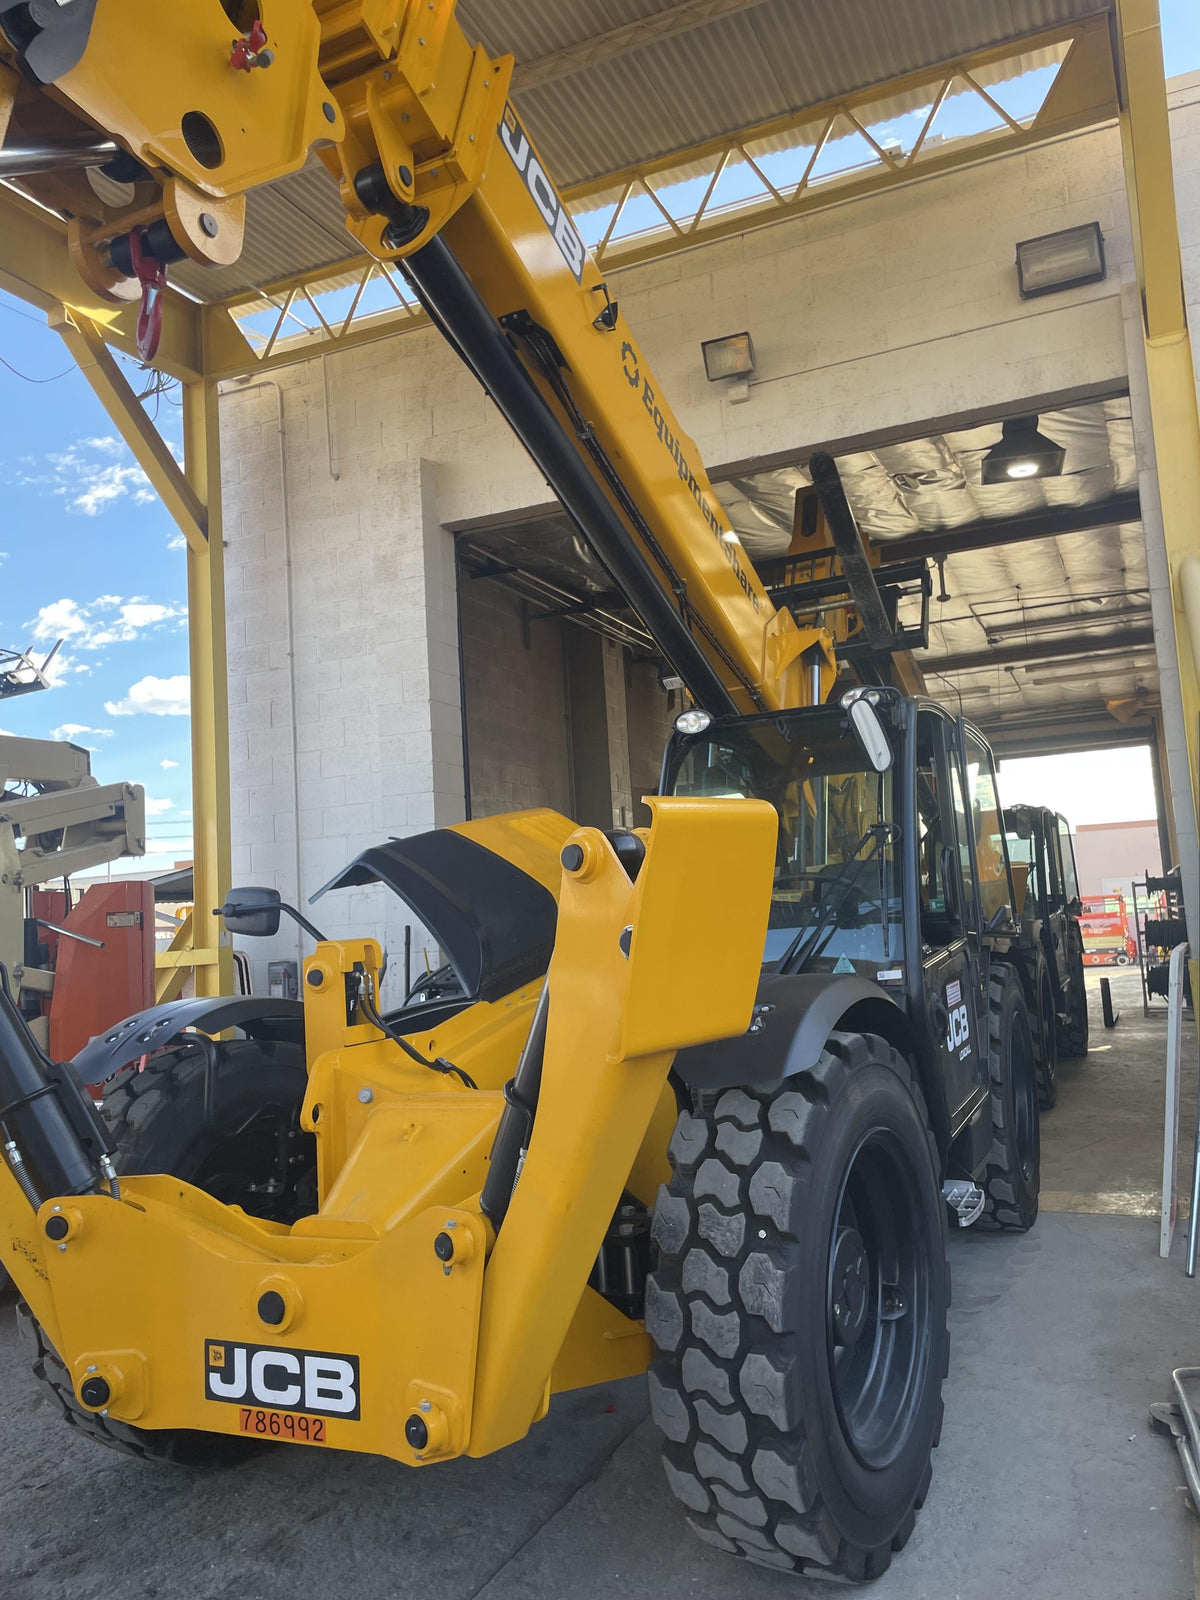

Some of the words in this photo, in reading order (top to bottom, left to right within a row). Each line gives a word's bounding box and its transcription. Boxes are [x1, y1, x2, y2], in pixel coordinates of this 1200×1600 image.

[501, 121, 584, 276] JCB
[946, 1004, 970, 1052] JCB
[208, 1347, 356, 1413] JCB
[241, 1408, 324, 1442] 786992
